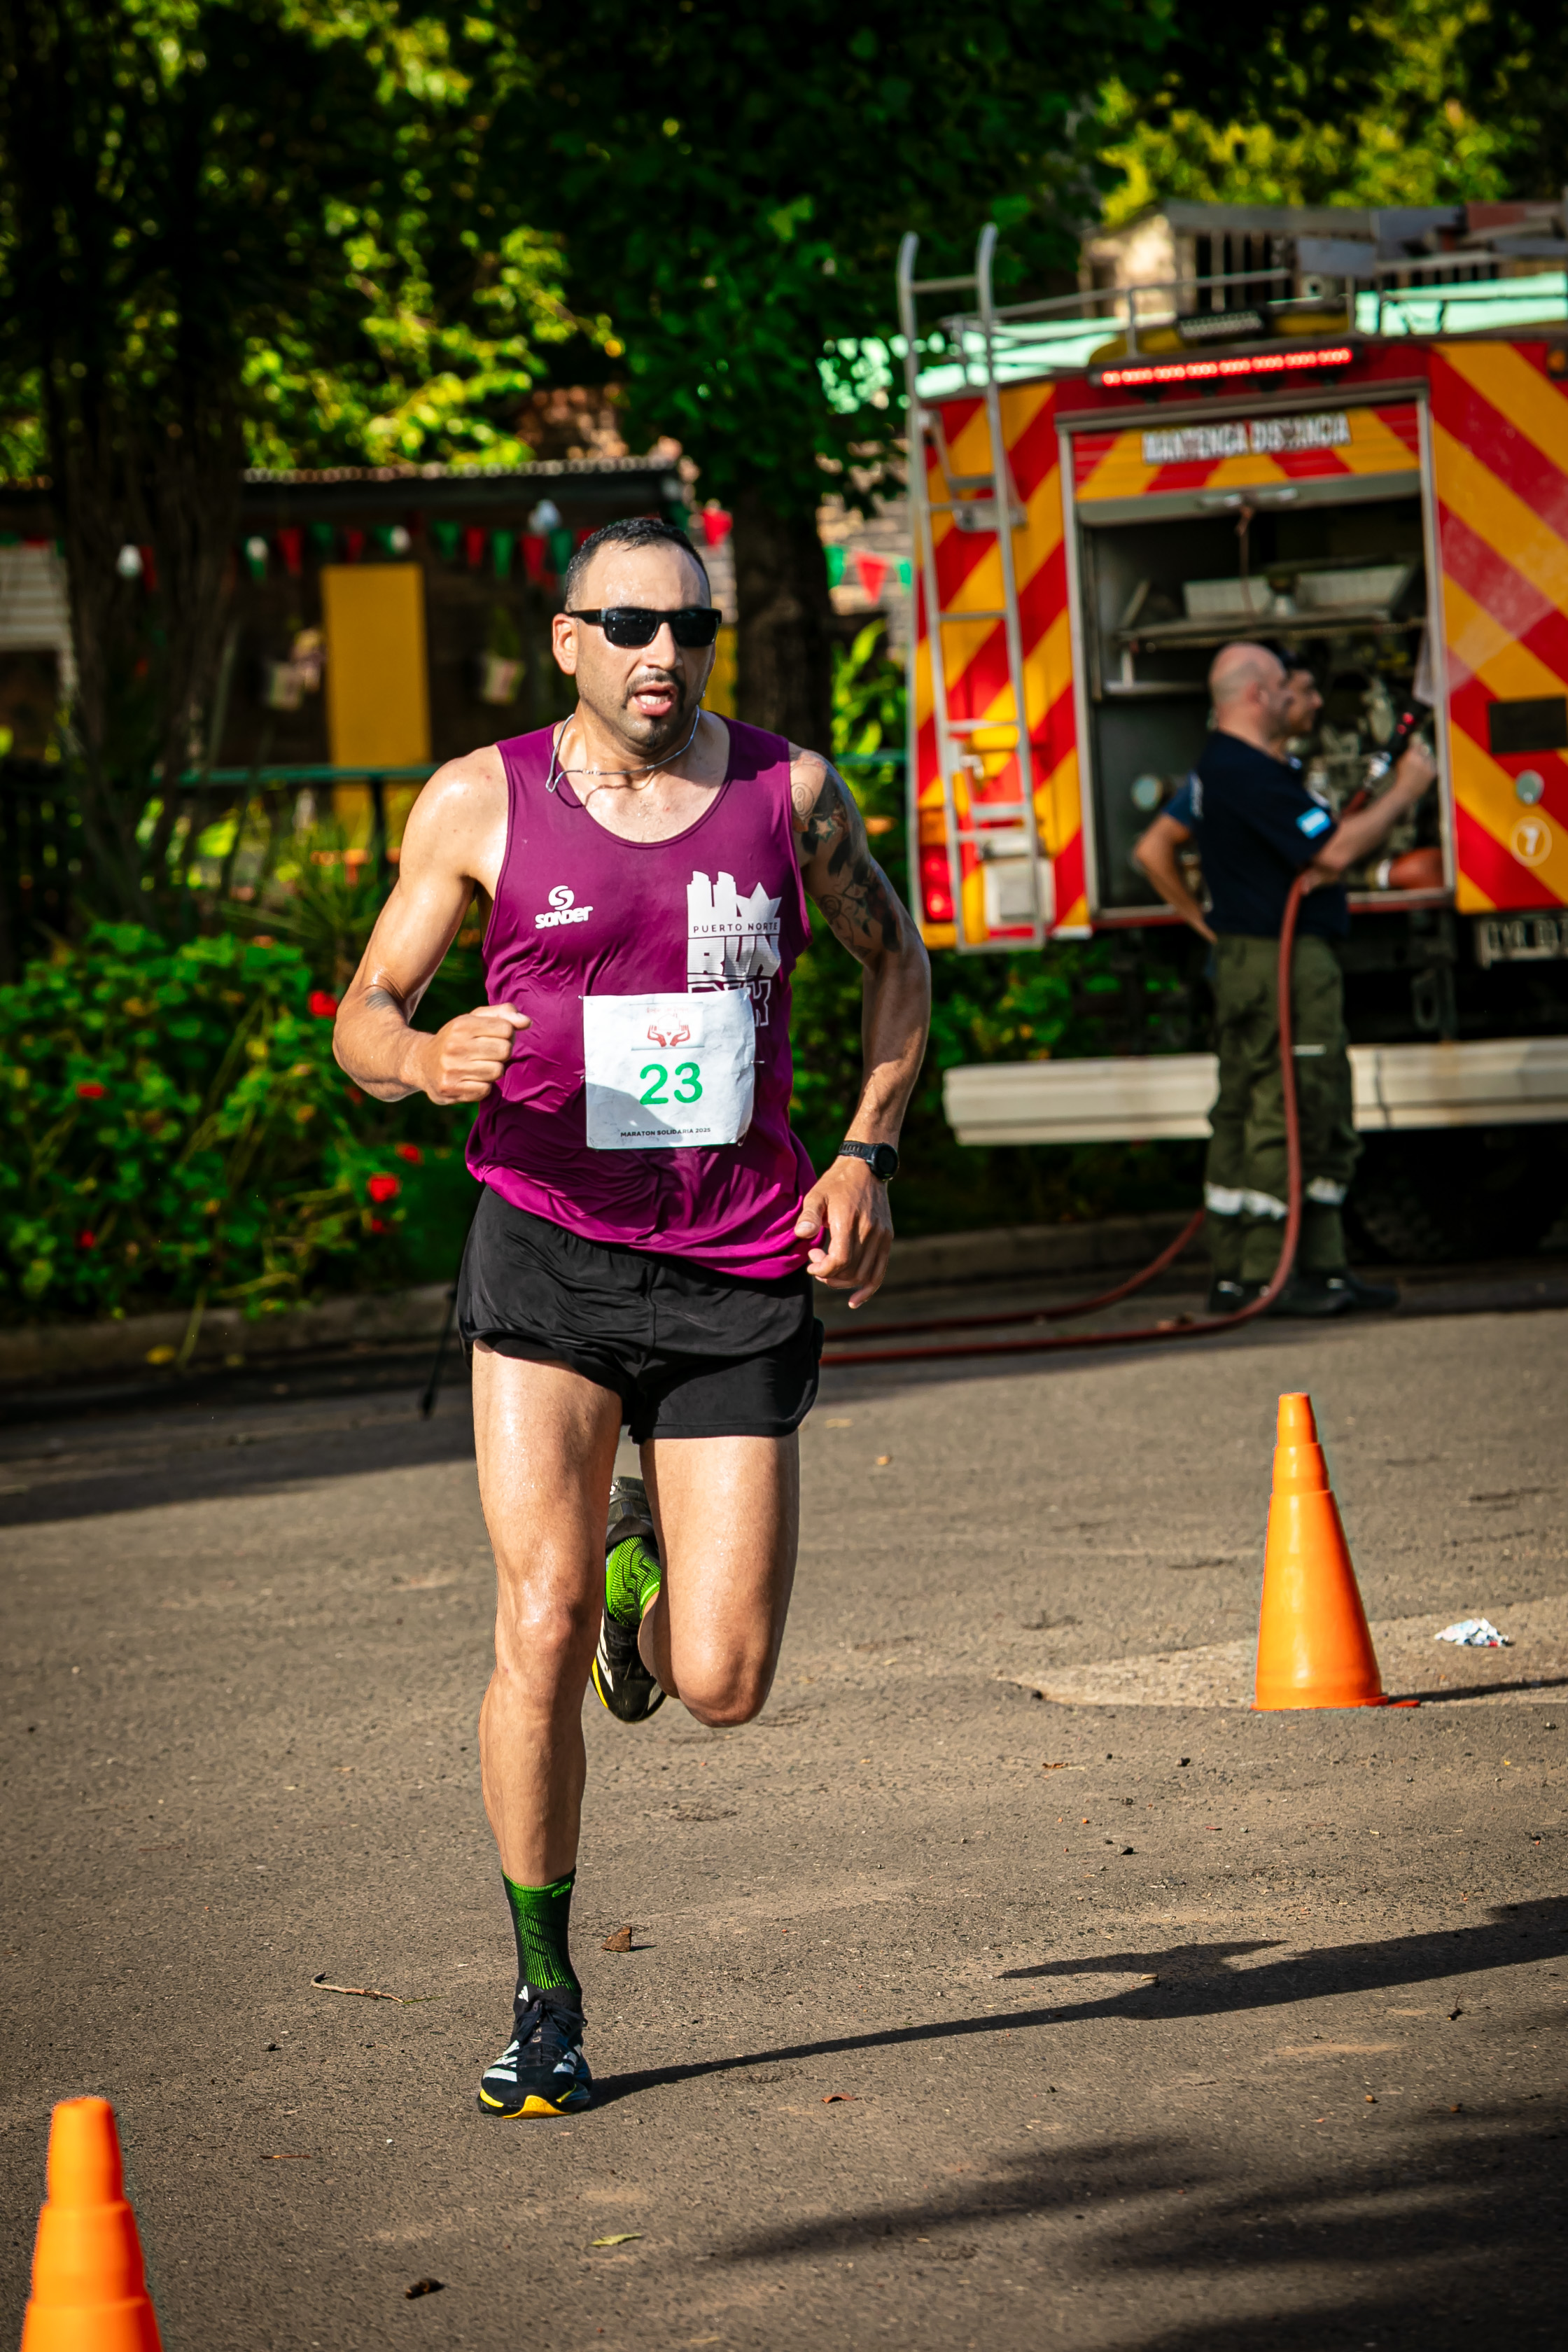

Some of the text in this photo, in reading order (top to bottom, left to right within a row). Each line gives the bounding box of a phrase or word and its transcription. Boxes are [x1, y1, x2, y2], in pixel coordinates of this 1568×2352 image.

[1144, 413, 1350, 463] MANTENGA DISTANCIA
[693, 921, 778, 934] PUERTO NORTE
[687, 935, 781, 977] RUN
[639, 1062, 704, 1105] 23
